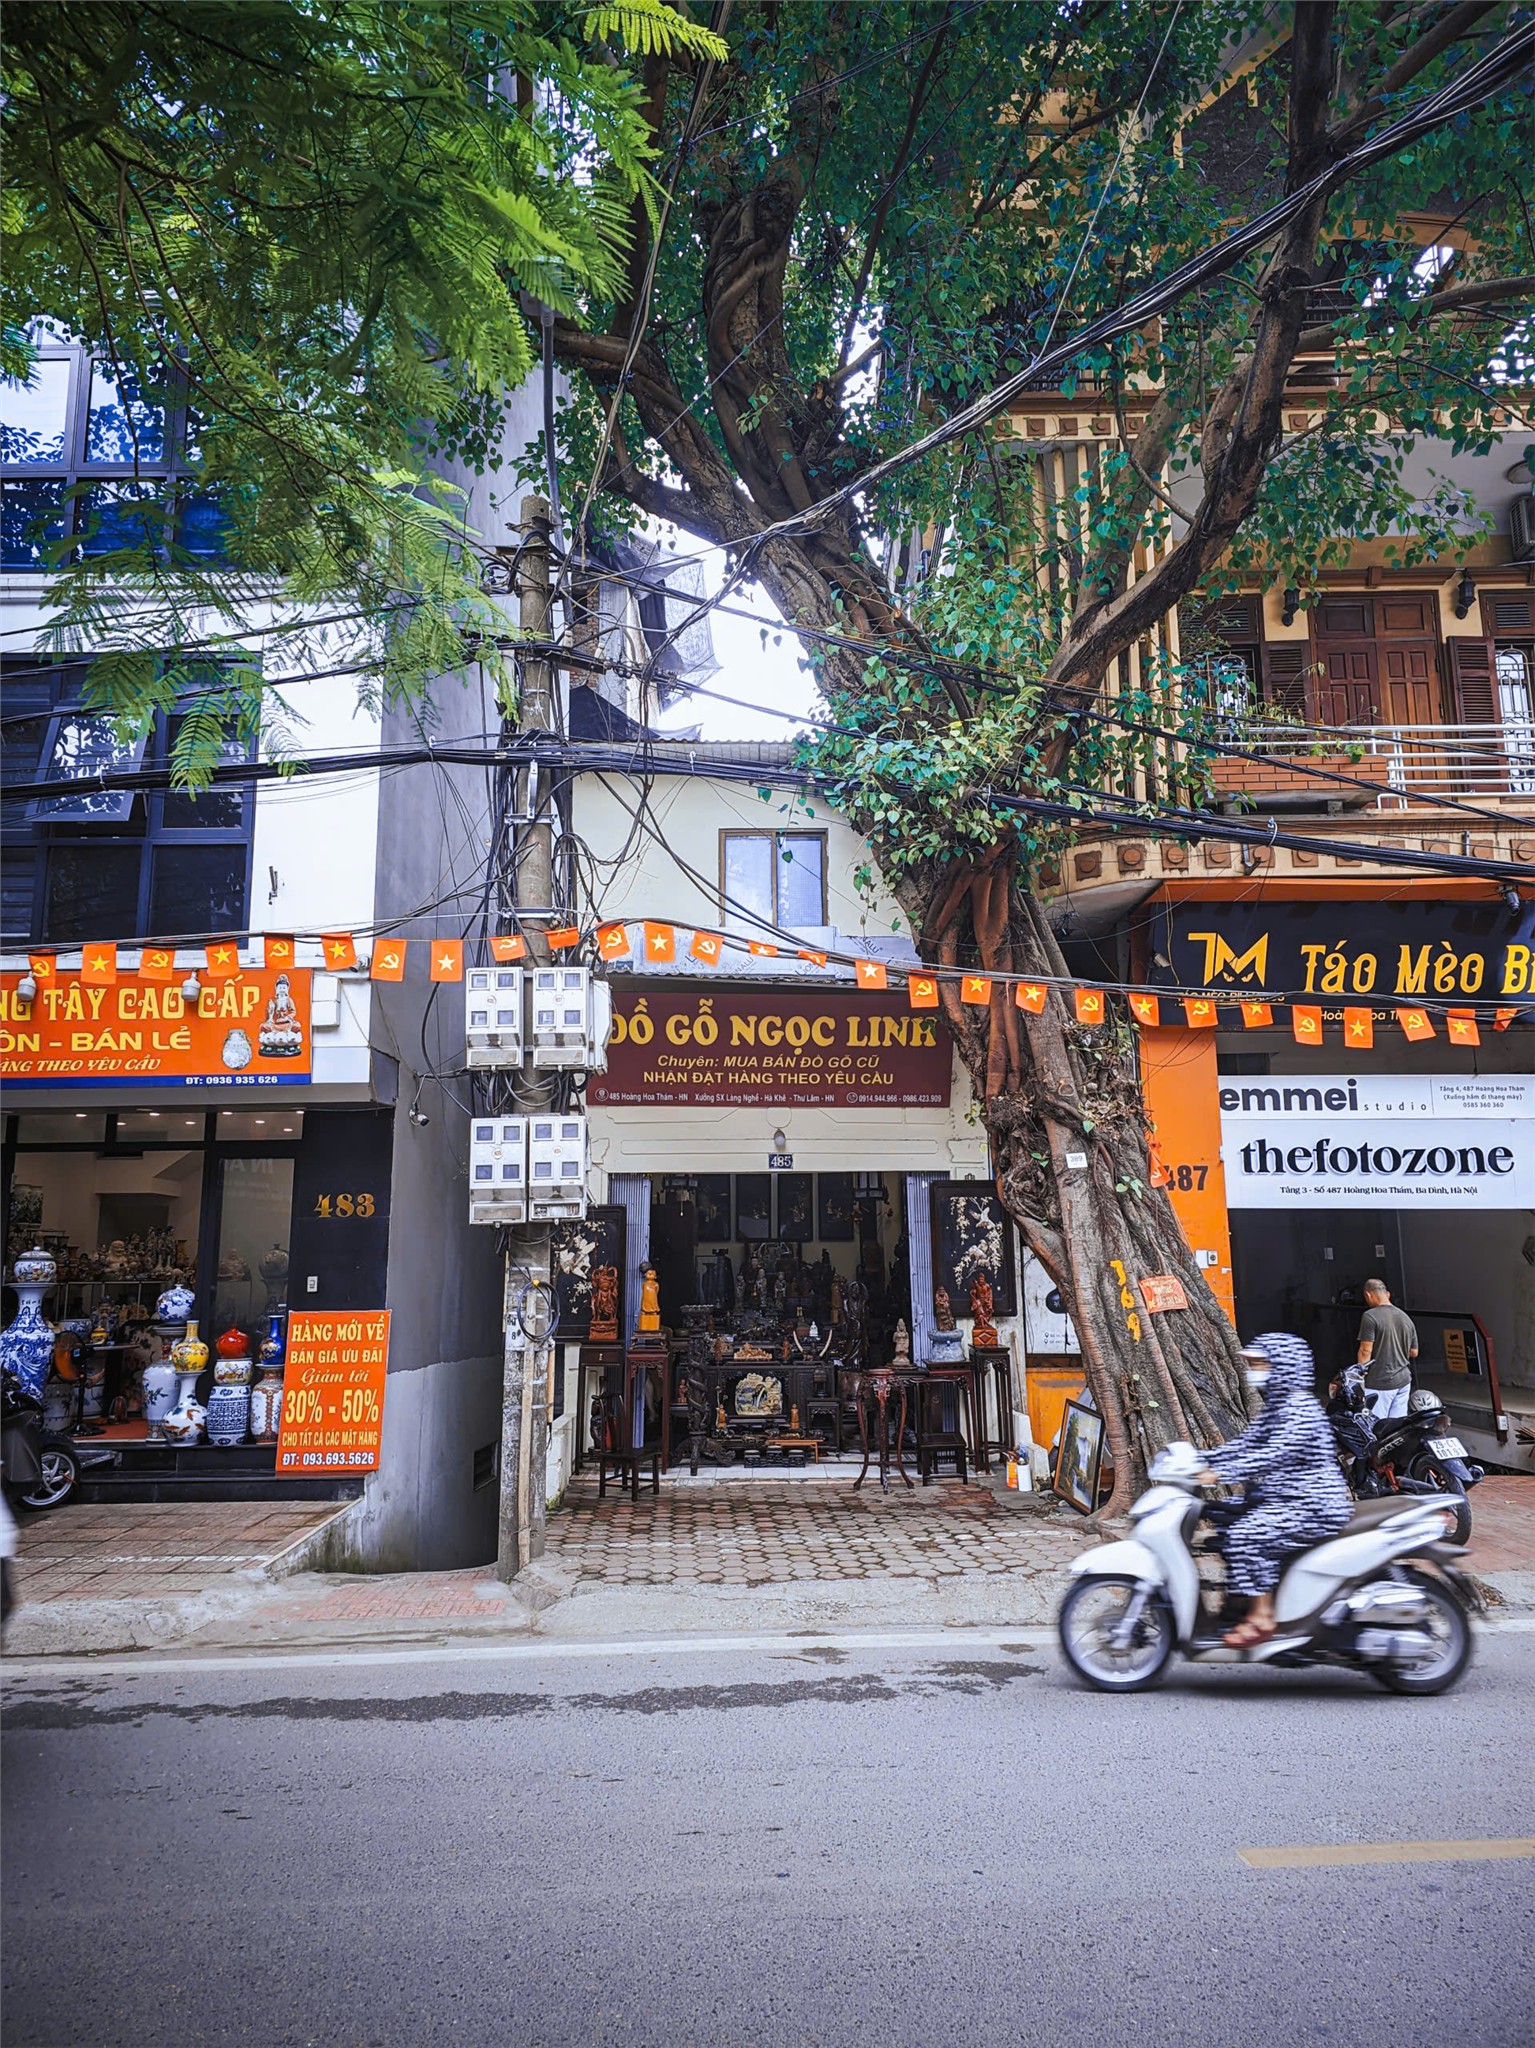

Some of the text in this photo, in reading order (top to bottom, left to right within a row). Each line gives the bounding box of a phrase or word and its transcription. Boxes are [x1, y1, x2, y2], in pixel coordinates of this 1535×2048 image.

[1300, 939, 1535, 994] Táo Mèo B
[43, 981, 107, 1021] TÂY
[118, 987, 185, 1020] CAO
[198, 974, 260, 1018] CẤP
[609, 998, 938, 1055] ĐỒ GỖ NGỌC LINH
[71, 1027, 142, 1052] BÁN
[152, 1025, 191, 1050] LẺ
[37, 1060, 83, 1072] THEO
[87, 1056, 122, 1070] YÊU
[124, 1054, 161, 1071] CẦU
[657, 1055, 719, 1069] Chuyên:
[723, 1056, 758, 1068] MUA
[762, 1054, 797, 1068] BÁN
[856, 1054, 880, 1068] CŨ
[185, 1075, 278, 1085] ĐT: 0936 935 626
[643, 1069, 894, 1086] NHẬN ĐẶT HÀNG THEO YÊU CẦU
[621, 1092, 641, 1102] Hoàng
[679, 1093, 688, 1101] HN
[715, 1093, 725, 1102] SX
[726, 1093, 742, 1103] Làng
[824, 1094, 835, 1102] HN
[1219, 1078, 1427, 1112] emmei studio
[770, 1156, 791, 1167] 485
[1240, 1138, 1515, 1176] thefotozone
[1313, 1184, 1325, 1193] Số
[1343, 1185, 1370, 1195] Hoàng
[1450, 1185, 1462, 1193] Hà
[1463, 1185, 1478, 1195] Nội
[313, 1193, 375, 1218] 483
[291, 1314, 385, 1342] HÀNG MỚI VỀ
[290, 1347, 383, 1364] BÁN GIÁ ƯU ĐÃI
[301, 1367, 369, 1387] Giảm tới
[285, 1389, 323, 1423] 30%
[342, 1388, 379, 1423] 50%
[282, 1427, 378, 1449] CHO TẤT CẢ CÁC MẶT HÀNG
[282, 1452, 375, 1466] ĐT: 093.693.5626
